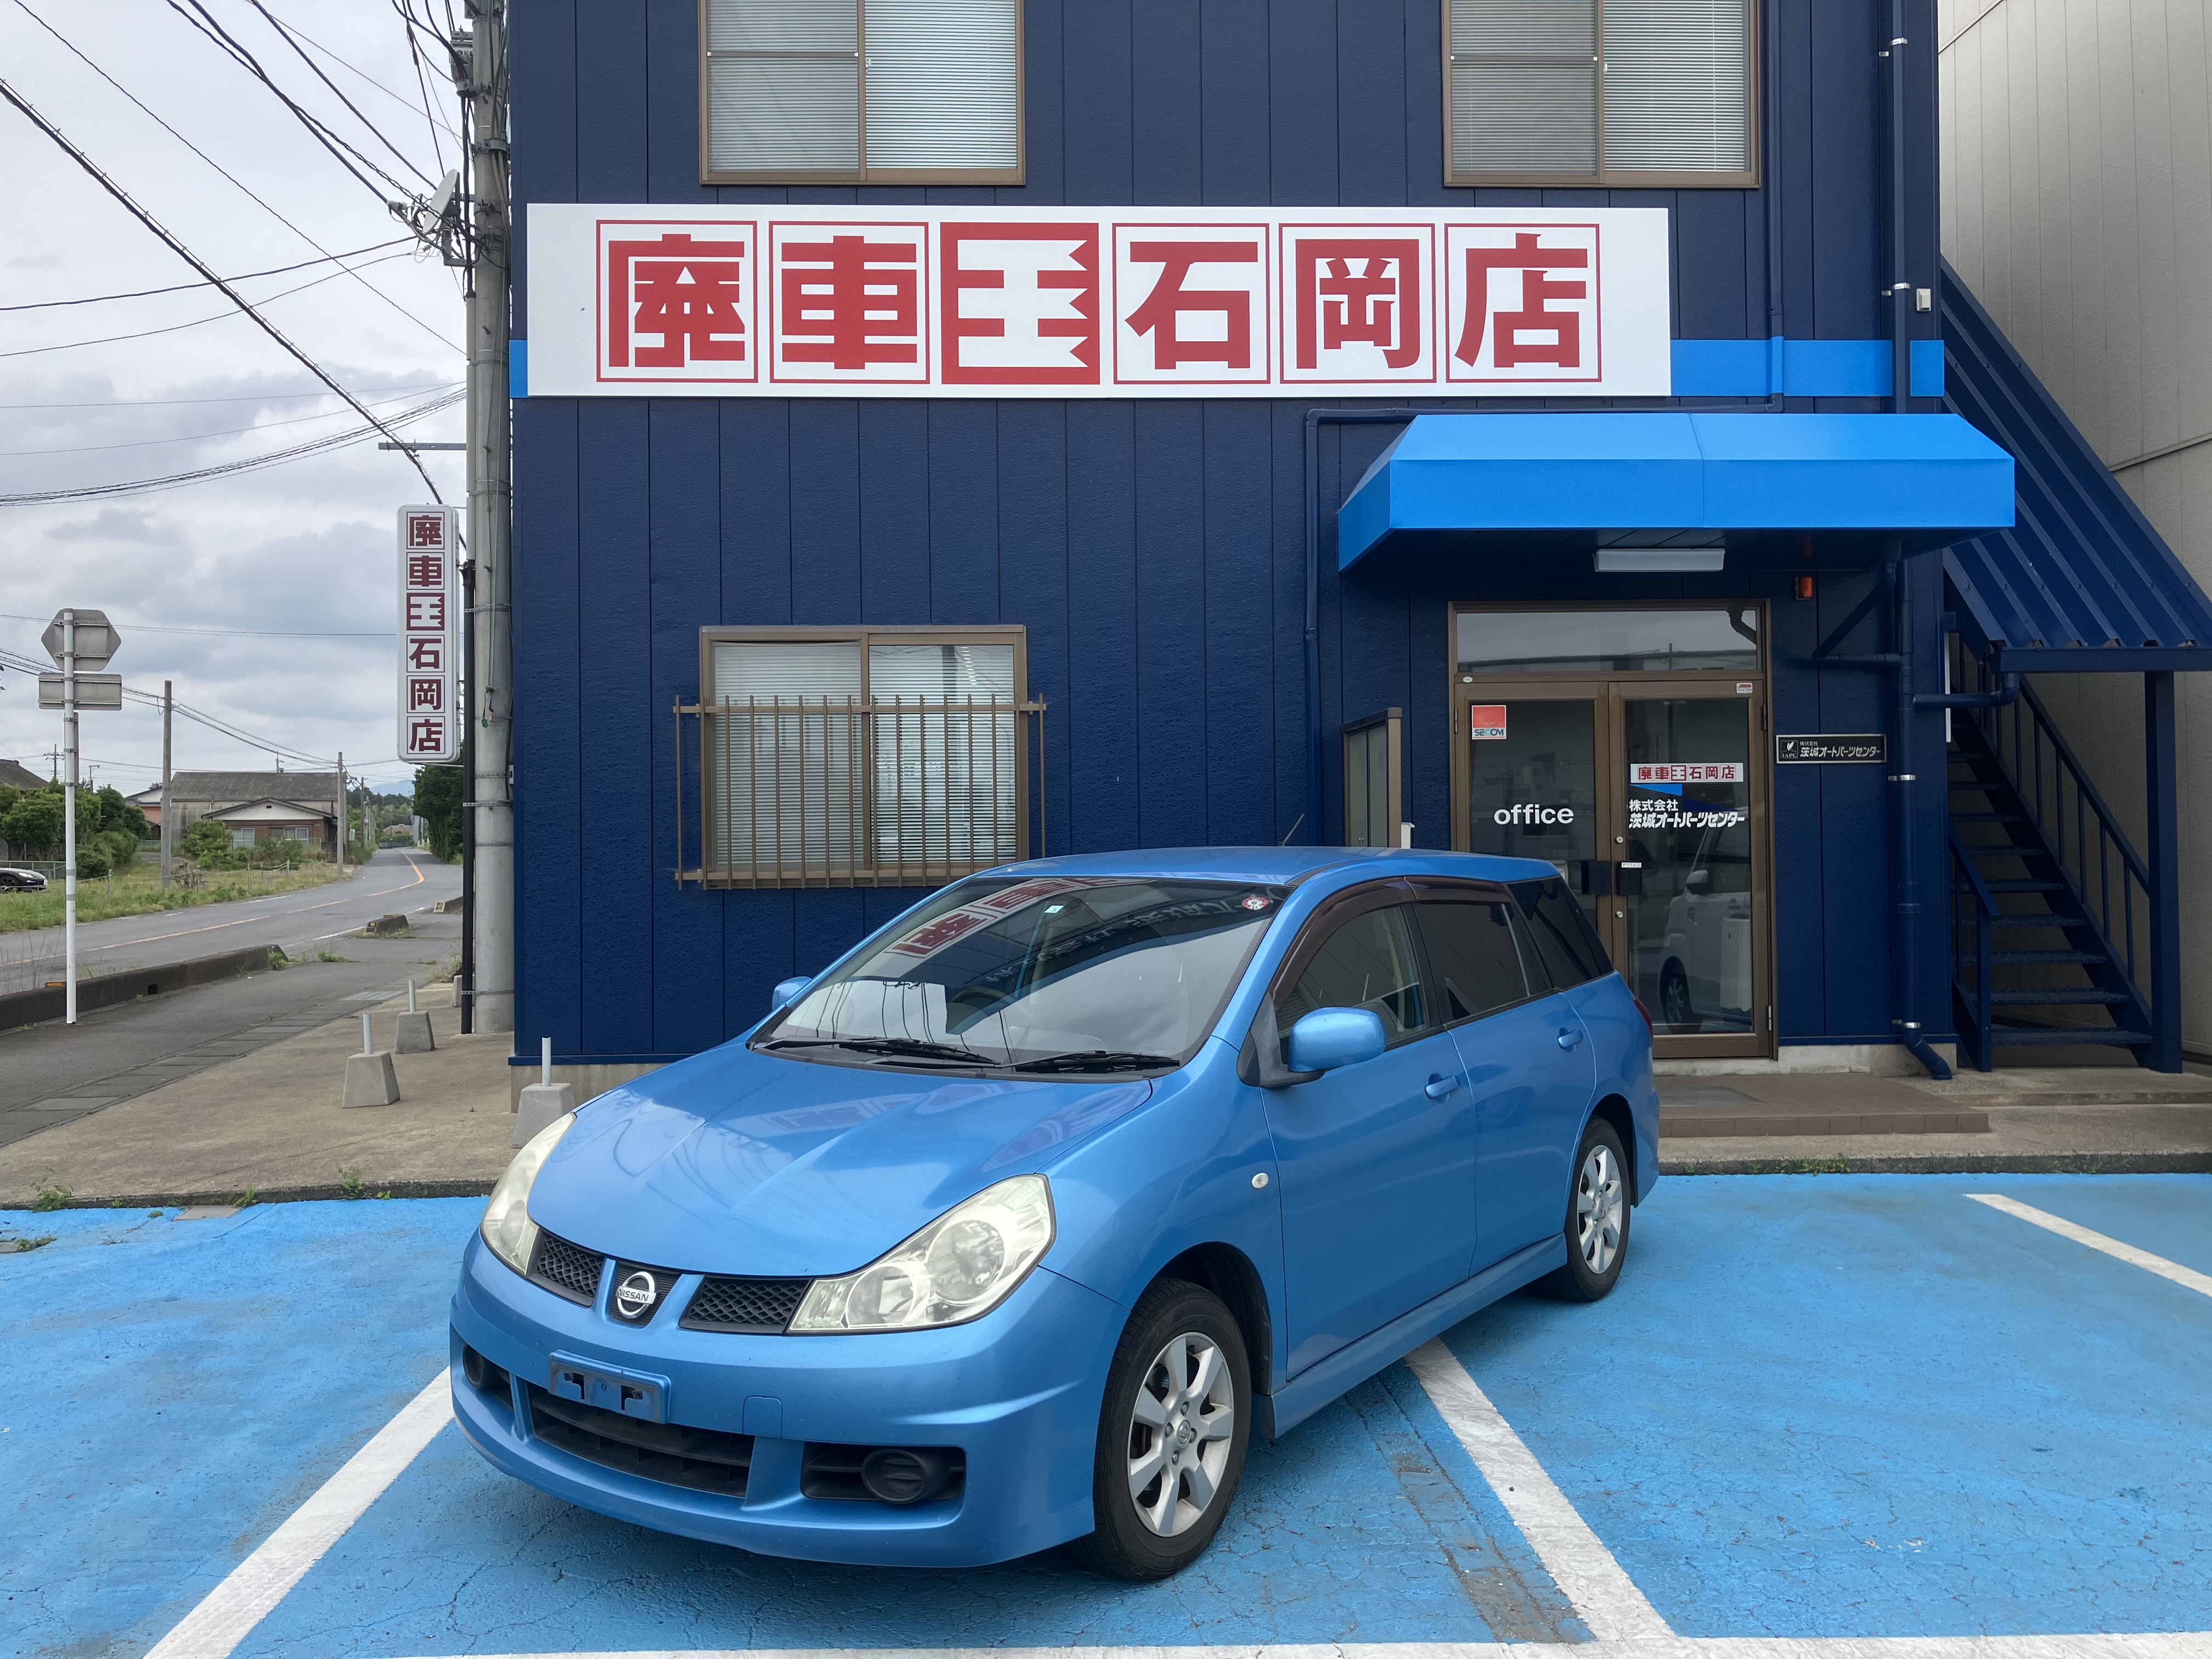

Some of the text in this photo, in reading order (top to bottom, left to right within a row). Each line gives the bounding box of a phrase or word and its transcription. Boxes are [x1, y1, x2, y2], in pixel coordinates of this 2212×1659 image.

[607, 222, 1589, 385] 廃車王石岡店
[407, 515, 444, 752] 廃車王石岡店
[1800, 746, 1881, 758] 茨城オートパーツセンター
[1638, 764, 1736, 781] 廃車王石岡店
[1629, 799, 1679, 811] 株式会社
[1493, 804, 1574, 825] office
[1628, 812, 1745, 828] 茨城オートパーツセンター
[618, 1289, 649, 1301] NISSAN
